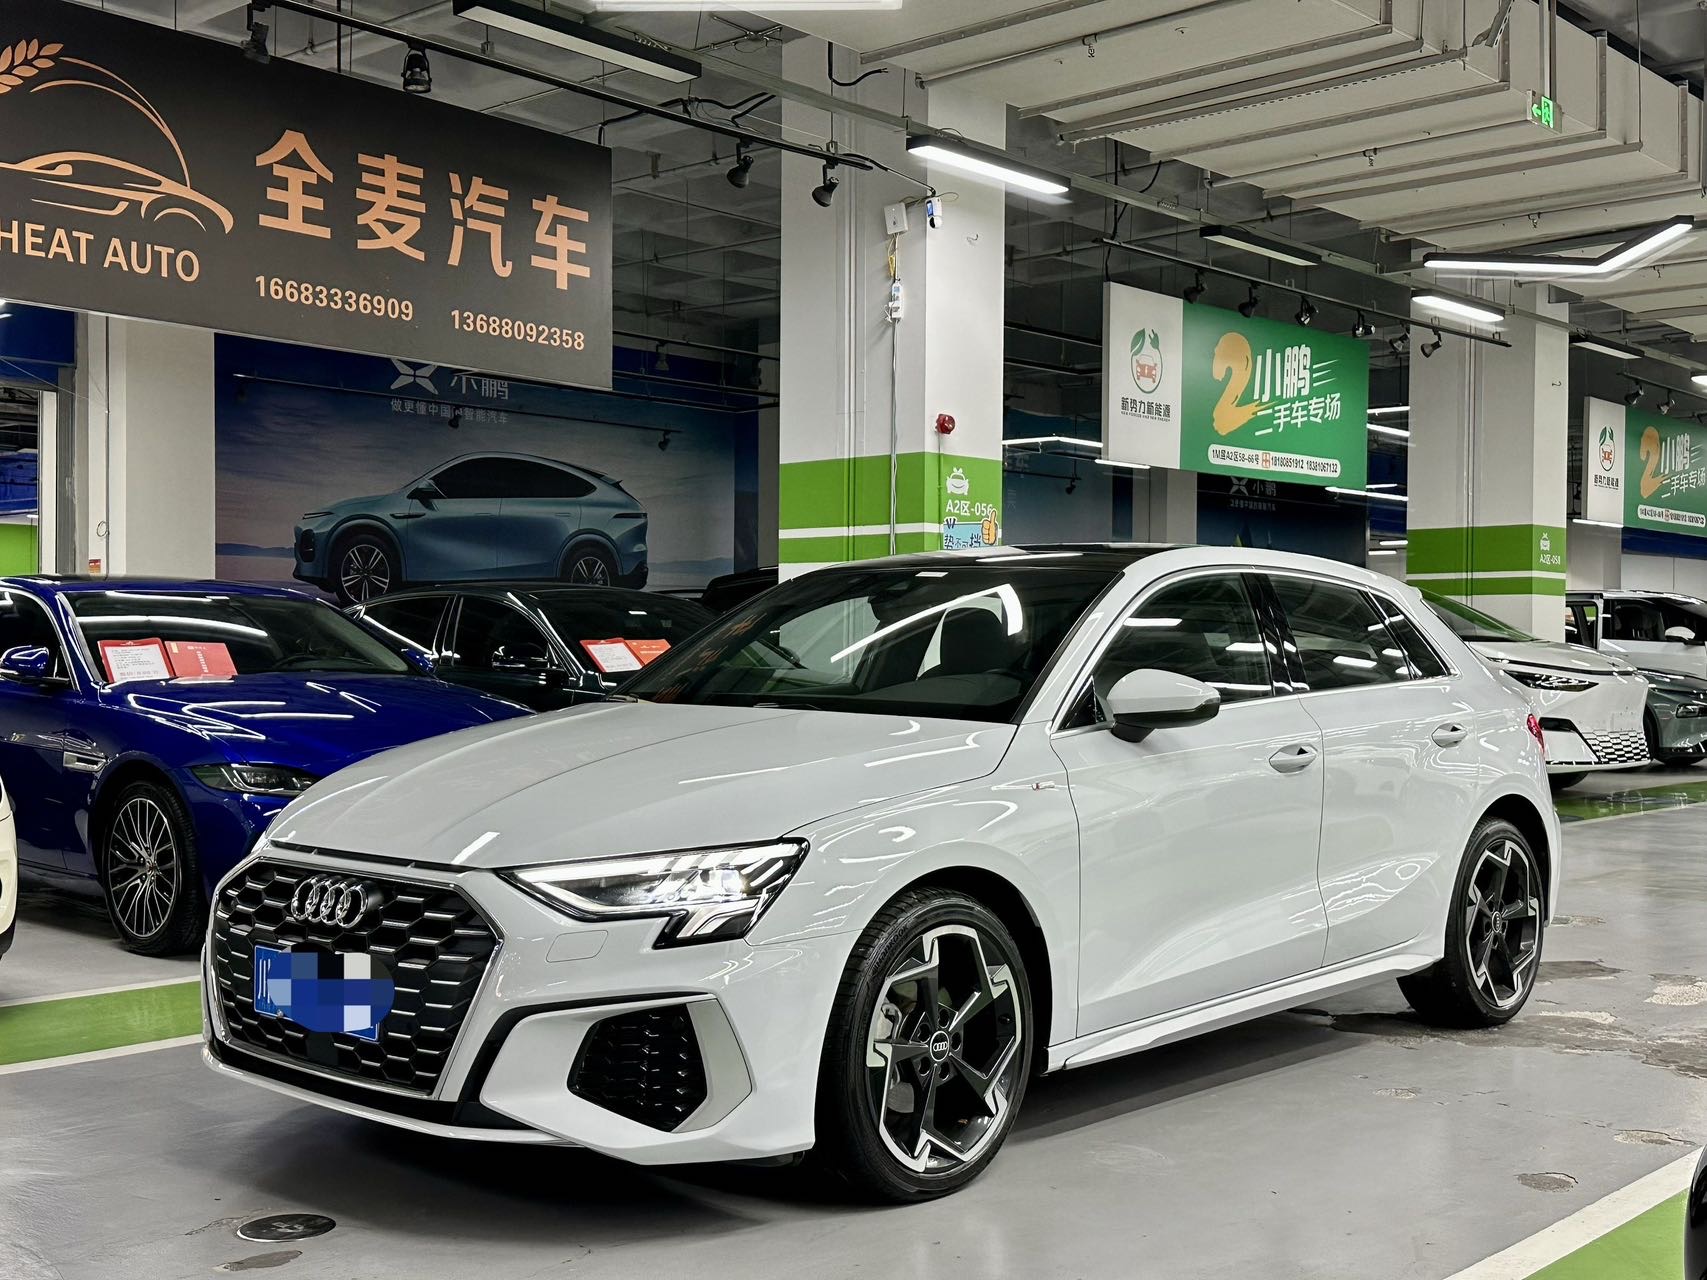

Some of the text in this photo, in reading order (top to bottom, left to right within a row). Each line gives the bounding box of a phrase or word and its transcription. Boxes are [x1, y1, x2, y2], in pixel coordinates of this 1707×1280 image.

[256, 129, 592, 290] 全麦汽车
[103, 237, 200, 282] AUTO
[255, 275, 585, 350] 16683336909 13688092358
[1253, 344, 1312, 403] 小鹏
[1255, 392, 1341, 436] 二手车专场
